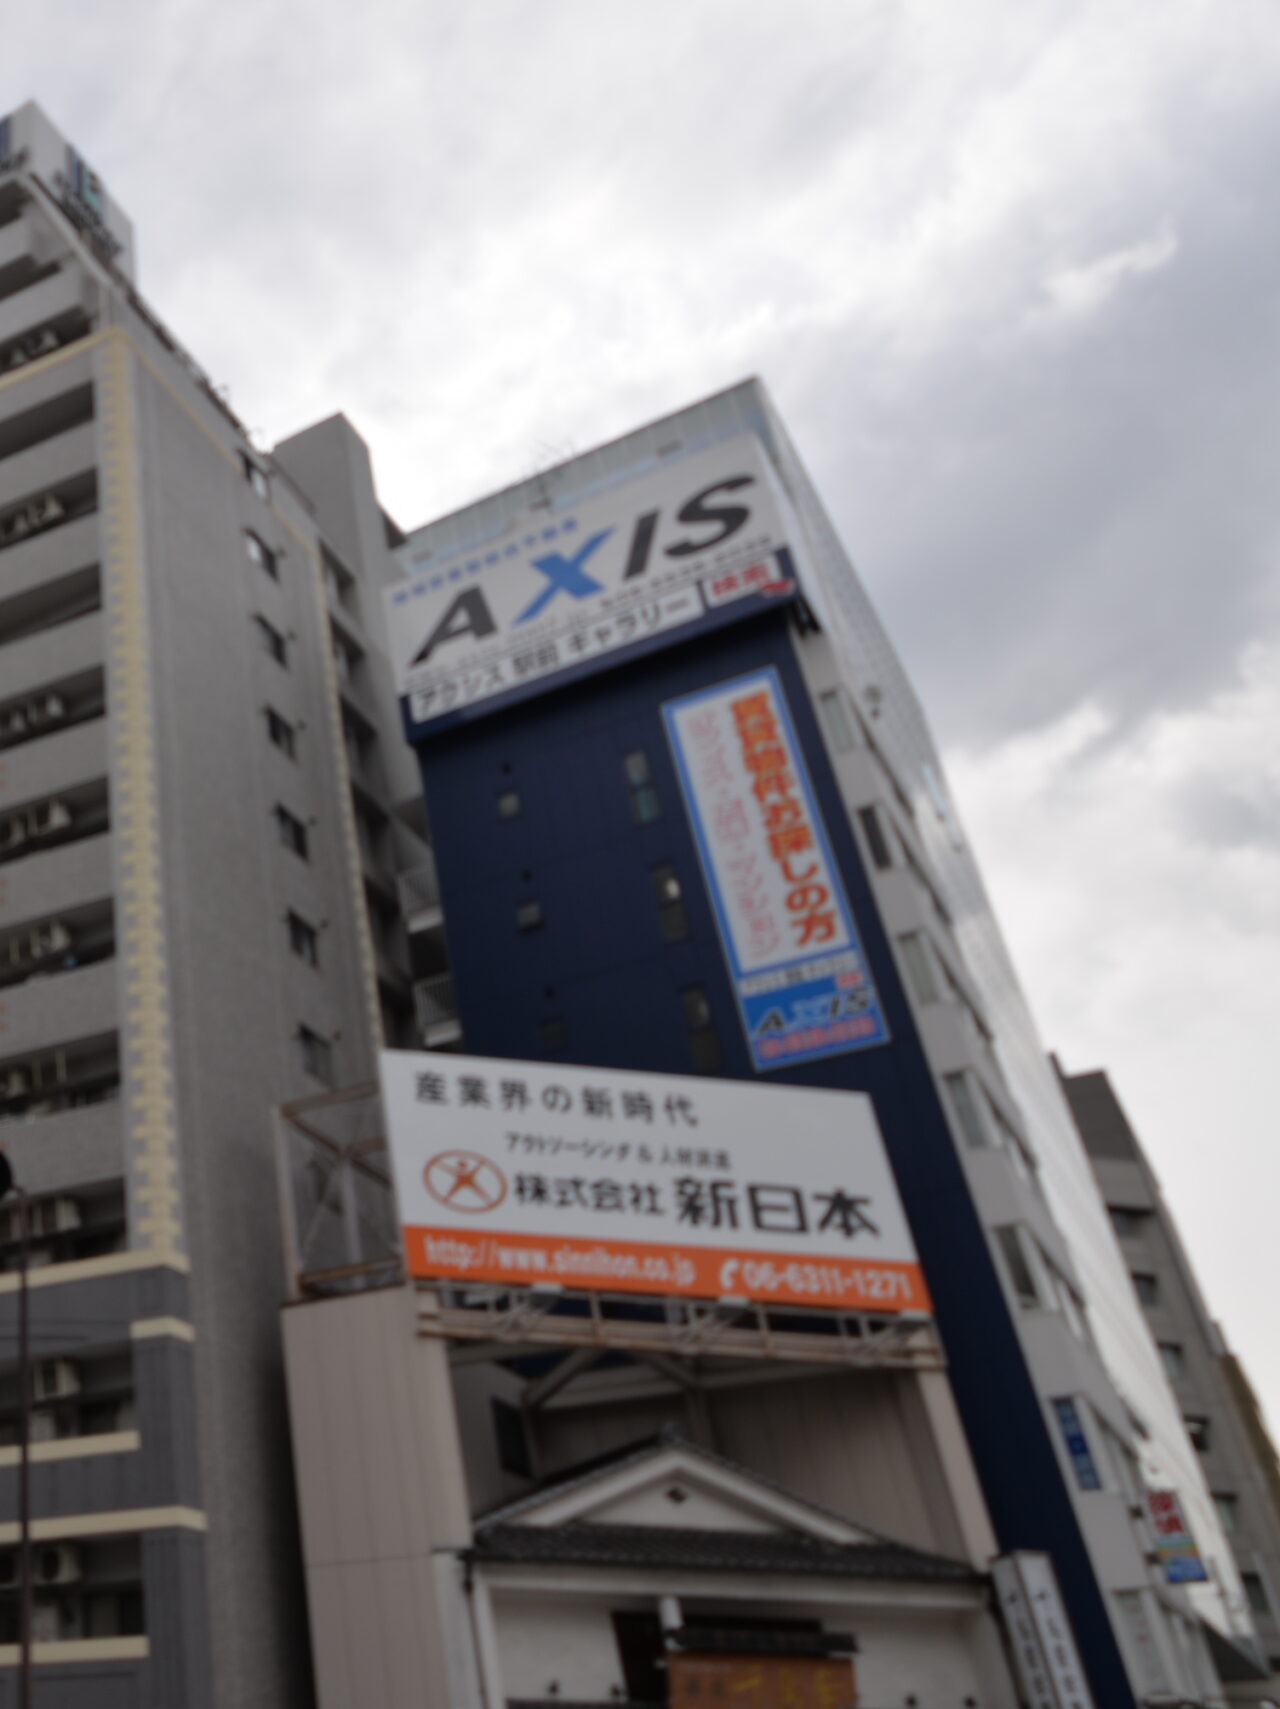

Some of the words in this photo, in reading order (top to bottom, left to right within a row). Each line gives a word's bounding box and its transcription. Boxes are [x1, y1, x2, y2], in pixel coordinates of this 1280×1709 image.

[409, 474, 756, 667] AXIS
[414, 1071, 699, 1128] 産業界の新時代
[514, 1169, 665, 1216] 株式会社
[672, 1174, 882, 1240] 新日本
